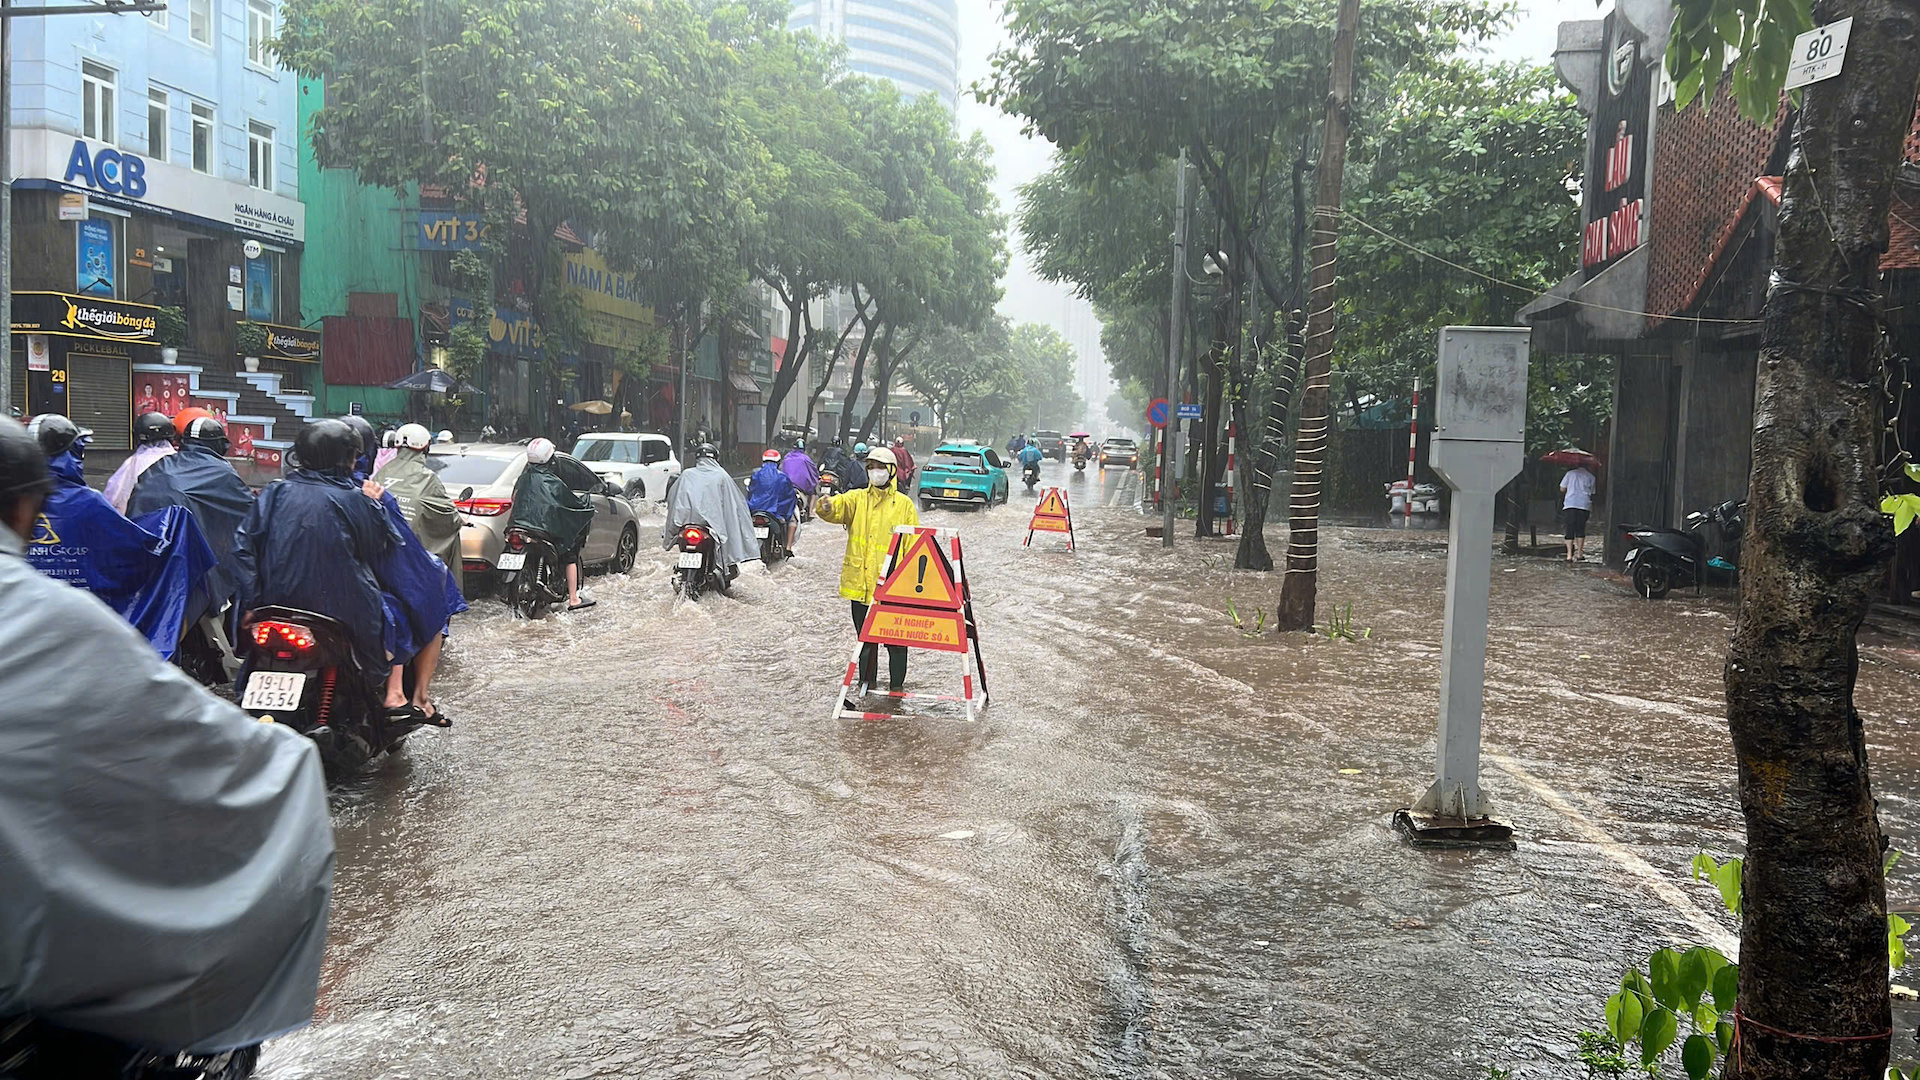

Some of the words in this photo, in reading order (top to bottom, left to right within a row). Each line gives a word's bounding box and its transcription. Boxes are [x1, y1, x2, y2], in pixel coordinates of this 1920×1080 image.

[1807, 34, 1832, 61] 80
[64, 140, 147, 198] ACB
[245, 245, 259, 254] ATM
[567, 261, 602, 293] NAM
[51, 369, 66, 383] 29
[904, 617, 935, 629] NGHIỆP
[879, 627, 905, 638] THOÁT
[906, 629, 929, 641] NƯỚC
[931, 632, 943, 642] SỐ
[944, 635, 950, 643] 4
[258, 675, 294, 691] 19-L1
[249, 691, 294, 707] 145.54
